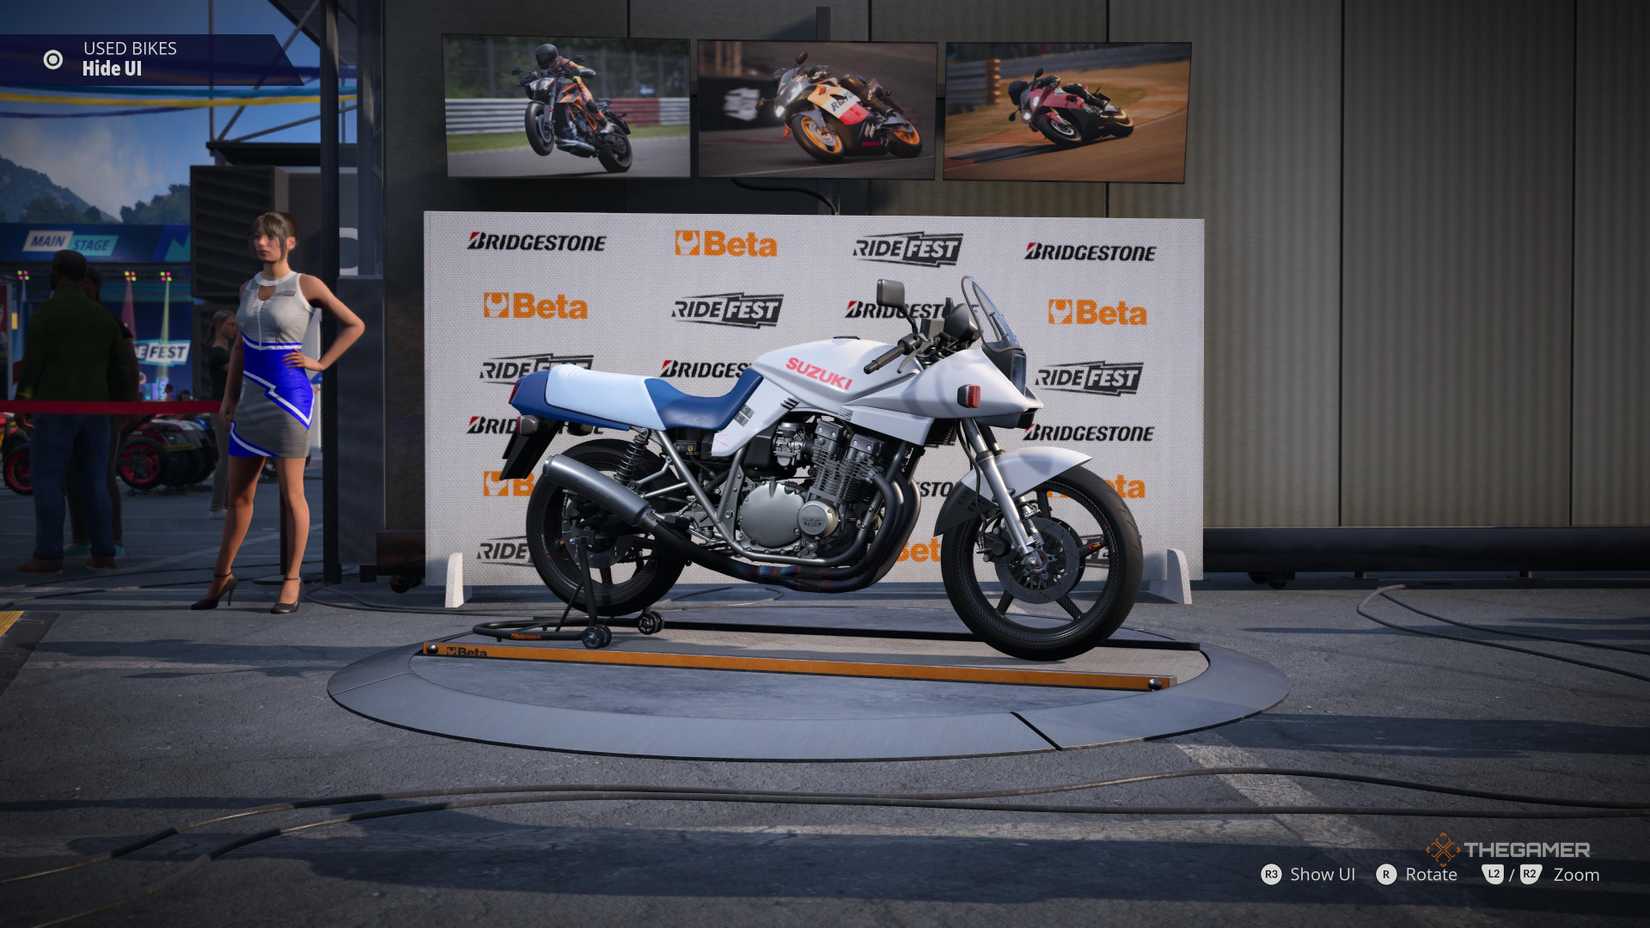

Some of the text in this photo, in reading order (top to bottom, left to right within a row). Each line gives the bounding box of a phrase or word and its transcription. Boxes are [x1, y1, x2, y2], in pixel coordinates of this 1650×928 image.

[30, 235, 111, 251] MAIN STAGE
[467, 232, 608, 252] BRIDGESTONE
[703, 230, 778, 257] Beta
[1024, 241, 1157, 262] BRIDGESTONE
[512, 292, 589, 320] Beta
[1075, 299, 1148, 326] Beta
[150, 345, 187, 358] FEST
[660, 359, 751, 378] BRIDGES
[785, 356, 854, 391] SUZUKI
[1023, 423, 1155, 442] BRIDGESTONE
[477, 542, 529, 559] RIDE
